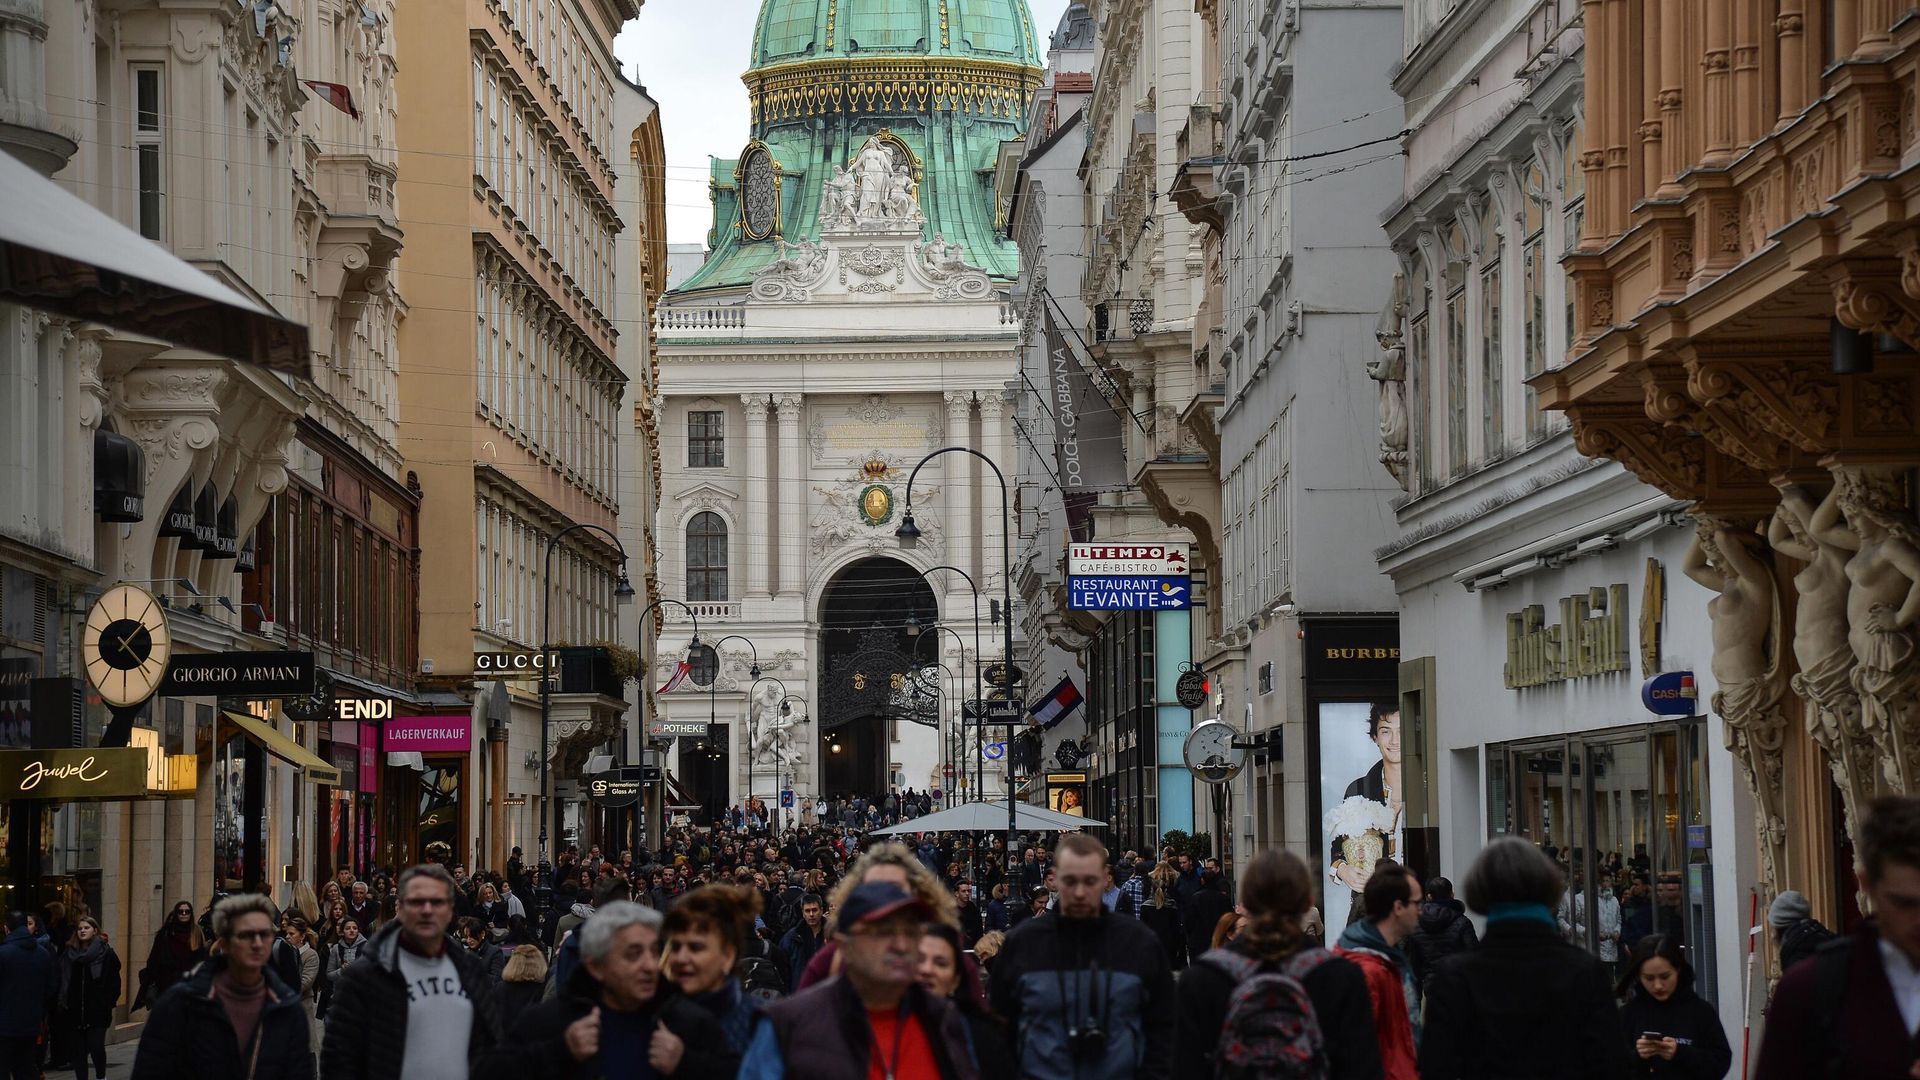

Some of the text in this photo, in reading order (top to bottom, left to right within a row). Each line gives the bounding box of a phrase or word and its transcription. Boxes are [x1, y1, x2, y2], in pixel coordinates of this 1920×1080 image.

[1053, 347, 1075, 427] GABBANA
[1066, 437, 1082, 487] DOLCE
[1092, 548, 1162, 559] TEMPO
[1073, 580, 1157, 591] RESTAURANT
[1073, 593, 1159, 607] LEVANTE
[477, 654, 556, 669] GUCCI
[173, 666, 299, 683] GIORGIO ARMANI
[389, 728, 465, 740] LAGERVERKAUF
[20, 756, 108, 790] Juwel
[592, 780, 607, 791] GS
